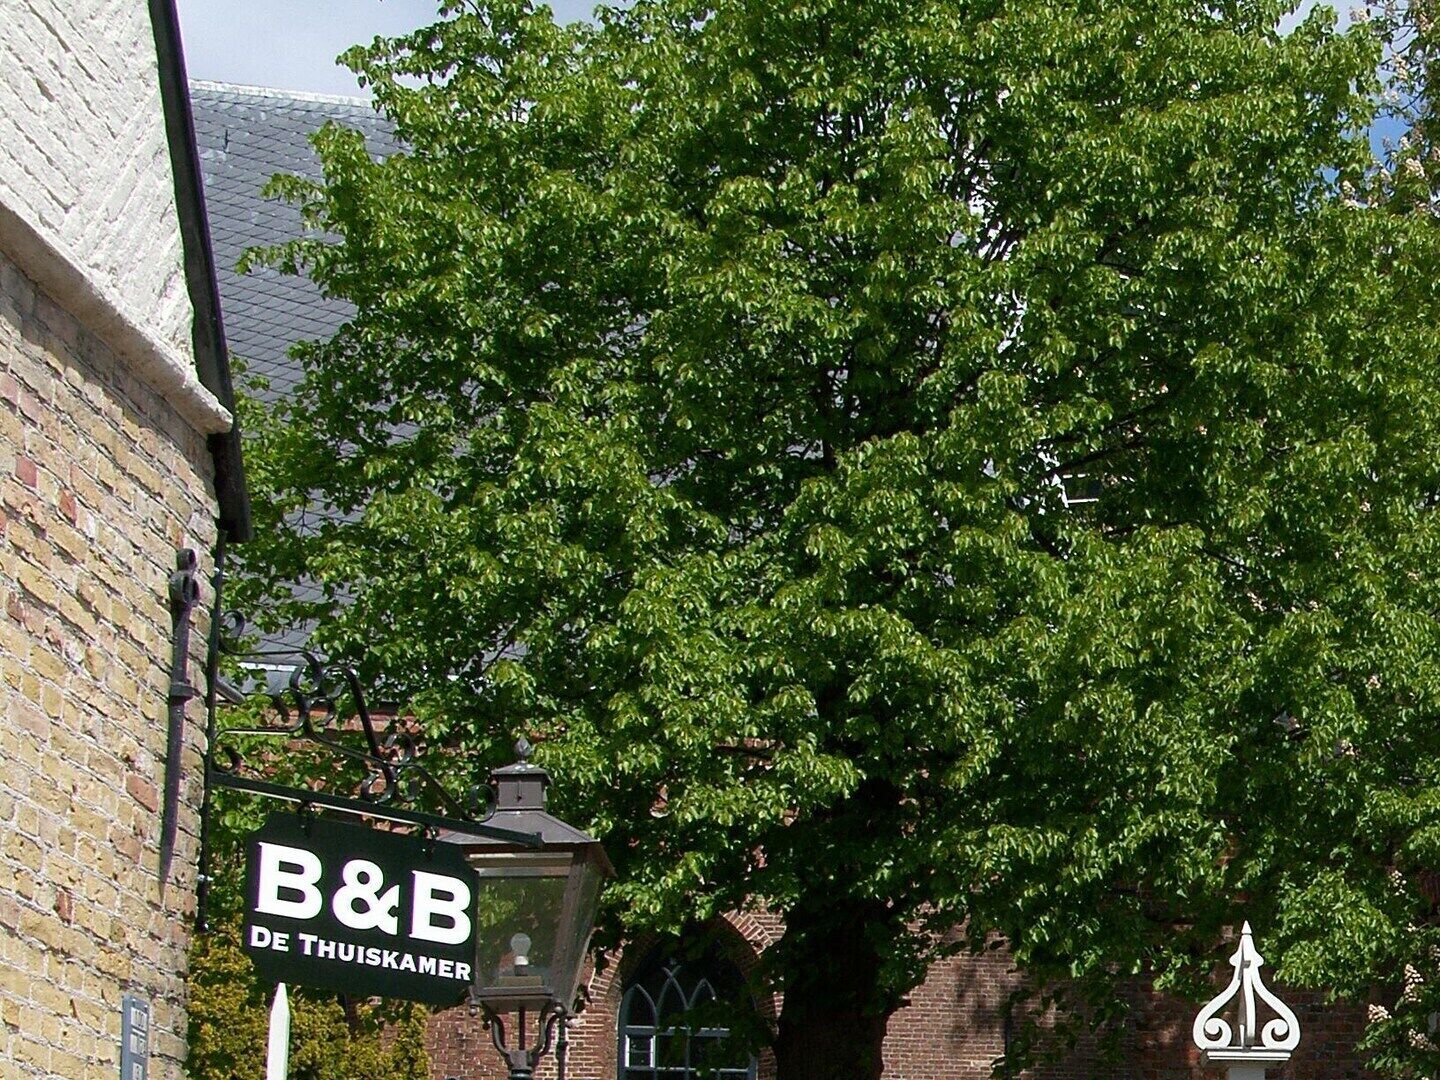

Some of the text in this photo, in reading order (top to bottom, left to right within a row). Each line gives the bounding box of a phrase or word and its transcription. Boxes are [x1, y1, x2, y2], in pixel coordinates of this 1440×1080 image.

[254, 842, 472, 945] B&B
[250, 925, 472, 981] DE THUISKAMER
